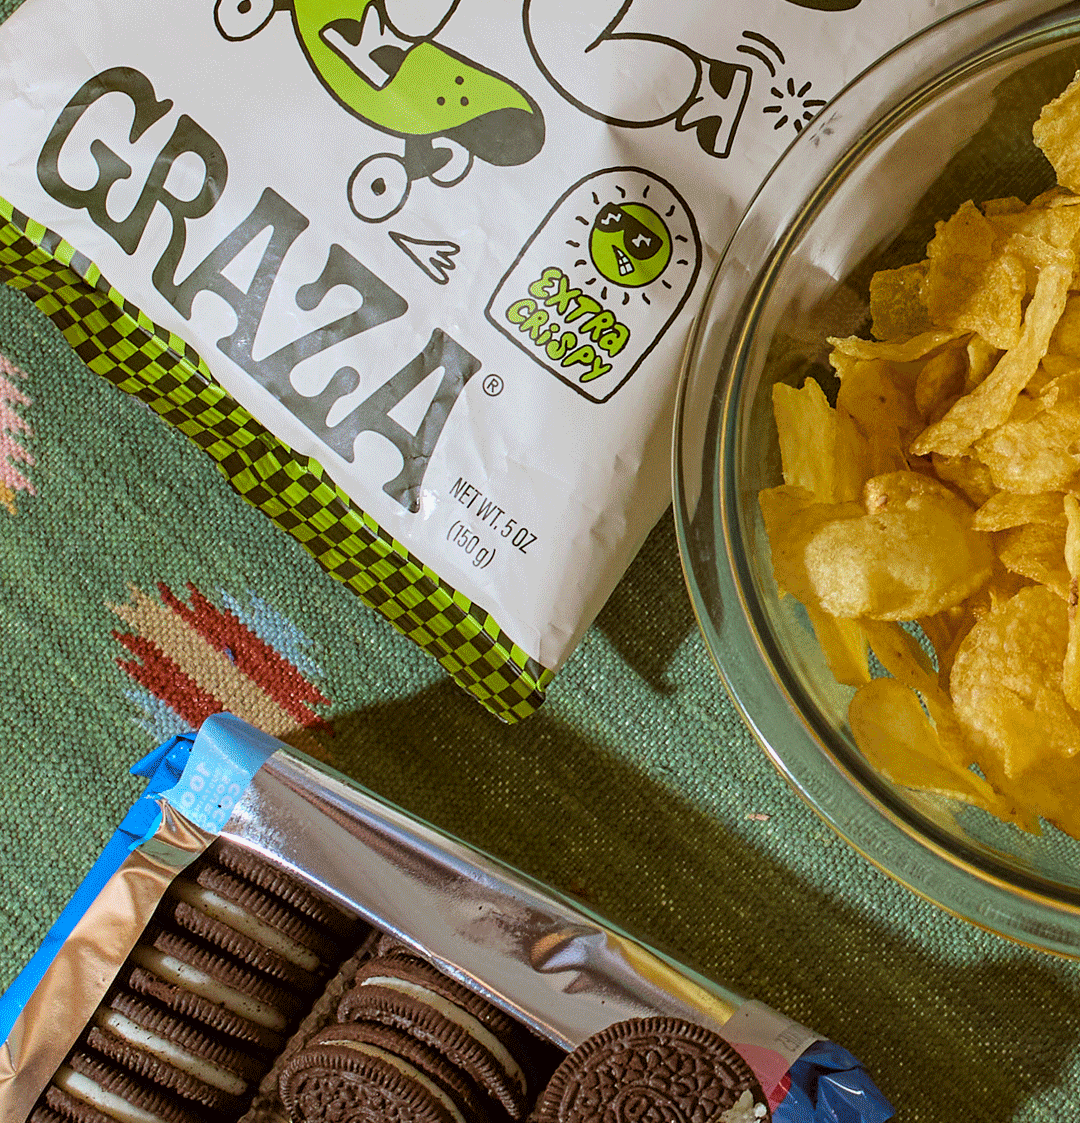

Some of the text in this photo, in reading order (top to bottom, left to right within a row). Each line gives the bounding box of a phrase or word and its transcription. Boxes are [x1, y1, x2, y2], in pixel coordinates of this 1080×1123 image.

[36, 66, 483, 514] GRAZA
[446, 520, 496, 570] (150 g)
[449, 477, 538, 555] NET WT. 5 OZ
